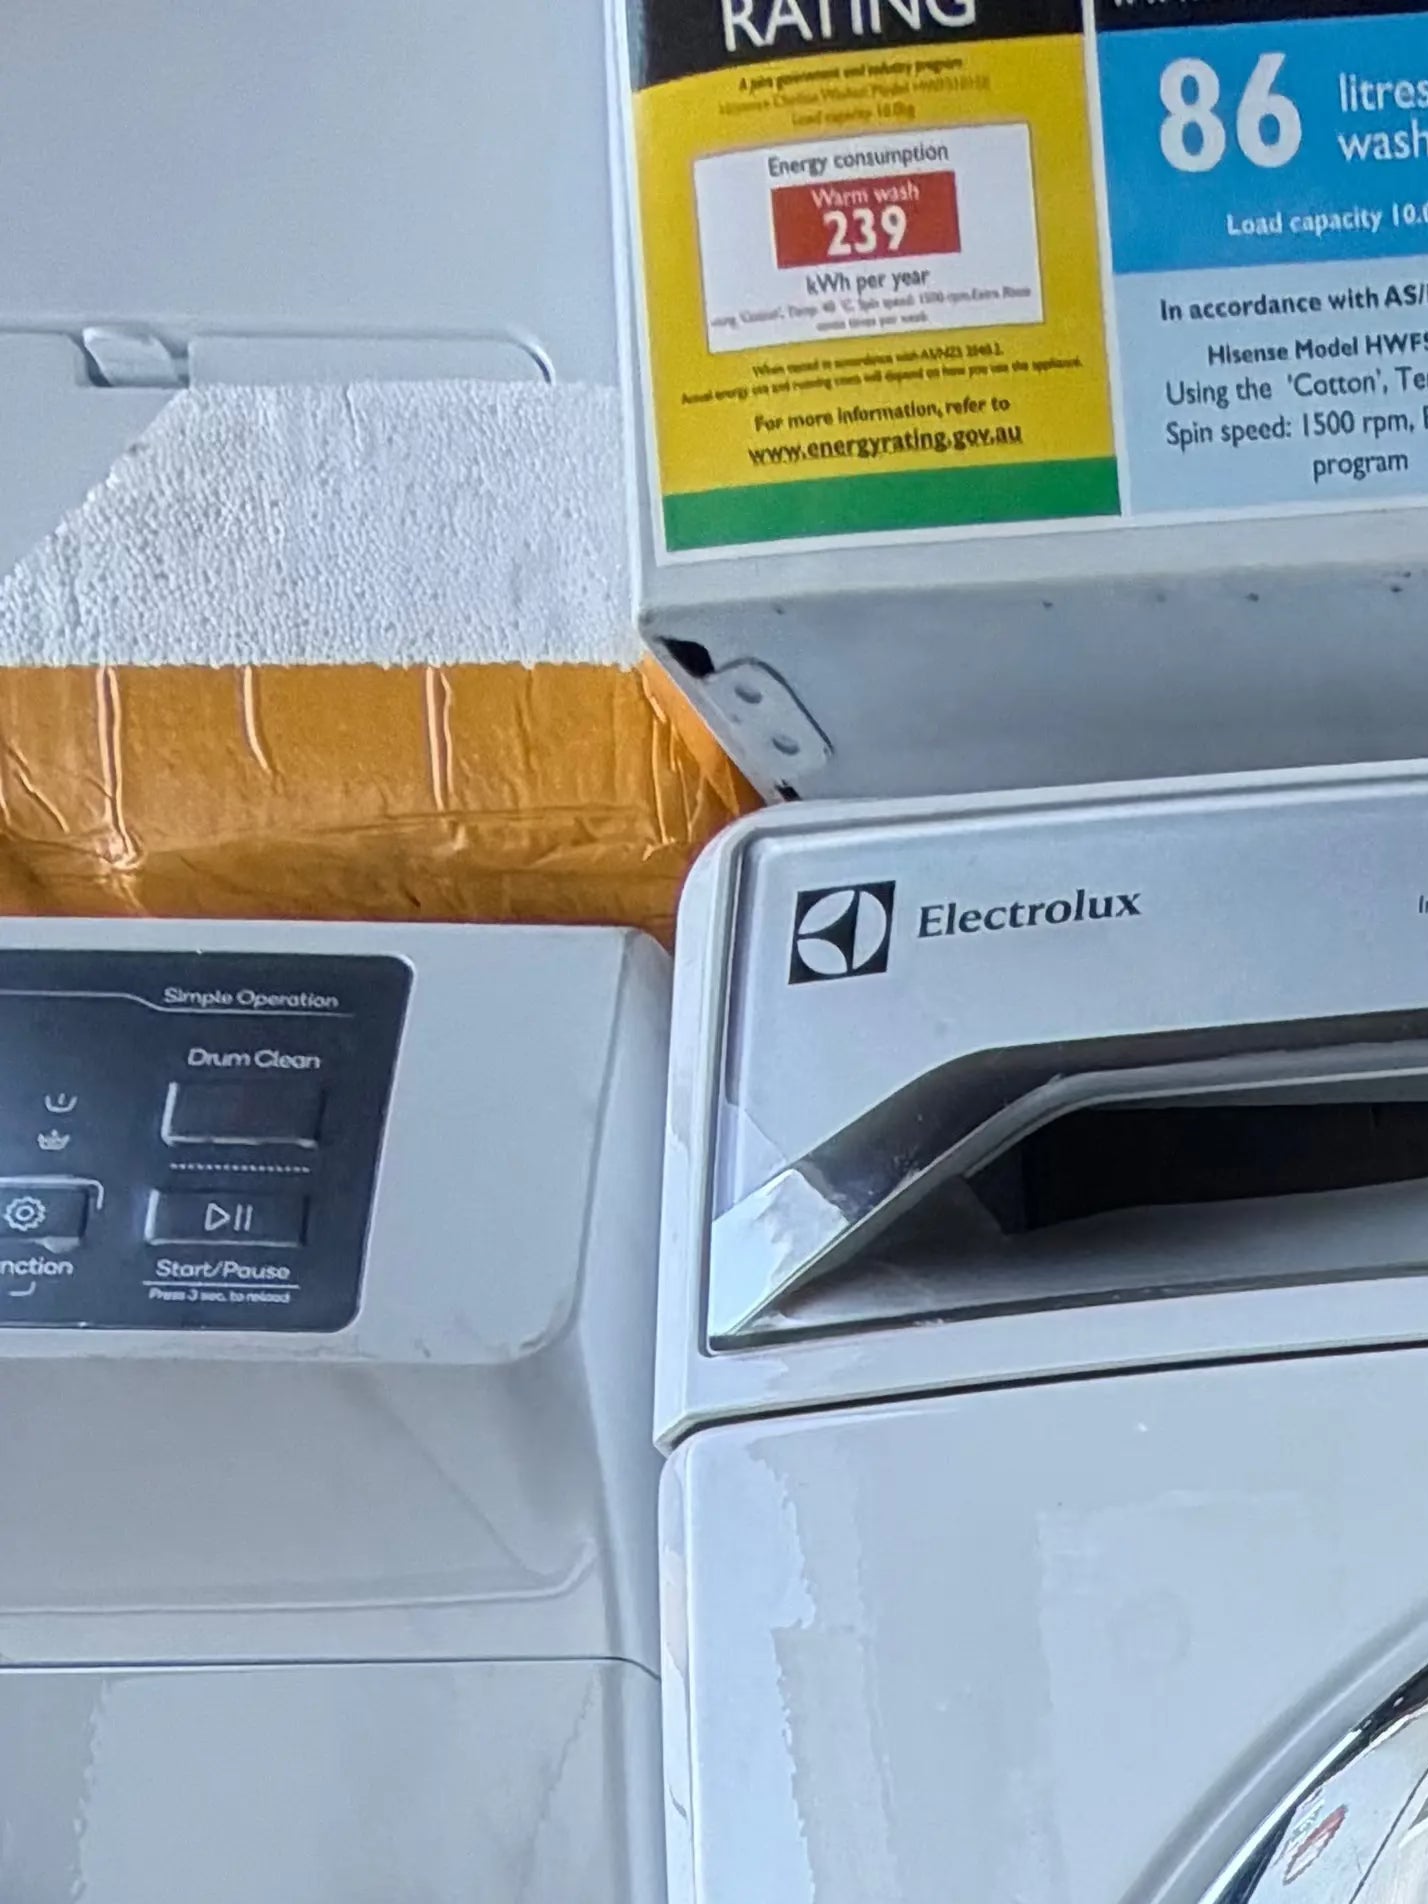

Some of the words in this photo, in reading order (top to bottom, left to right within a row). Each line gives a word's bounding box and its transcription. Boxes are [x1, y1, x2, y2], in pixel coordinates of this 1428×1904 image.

[1160, 52, 1302, 172] 86
[768, 155, 828, 178] Energy
[834, 142, 950, 169] consumption
[811, 187, 869, 209] Warm
[873, 180, 920, 204] wash
[823, 204, 908, 256] 239
[1227, 211, 1283, 237] Load
[1289, 206, 1382, 237] capacity
[806, 271, 851, 296] kWh
[856, 273, 886, 296] per
[892, 269, 931, 291] year
[1160, 299, 1182, 321] In
[1190, 293, 1322, 319] accordance
[1328, 288, 1378, 311] with
[1207, 343, 1288, 366] Hisense
[1295, 336, 1358, 360] Model
[1165, 379, 1229, 409] Using
[1235, 377, 1272, 400] the
[753, 414, 783, 432] For
[788, 410, 833, 428] more
[838, 399, 943, 424] information,
[945, 396, 984, 418] refer
[990, 395, 1010, 413] to
[748, 424, 1023, 466] www.energyrating.gov.au
[1165, 420, 1213, 454] Spin
[1220, 415, 1292, 448] speed:
[1302, 410, 1355, 437] 1500
[1362, 411, 1415, 439] rpm,
[1312, 451, 1409, 483] program
[918, 888, 1142, 938] Electrolux
[164, 986, 233, 1008] Simple
[237, 988, 339, 1009] Operation
[188, 1047, 250, 1066] Drum
[254, 1049, 321, 1069] Clean
[155, 1258, 291, 1280] Start/Pause
